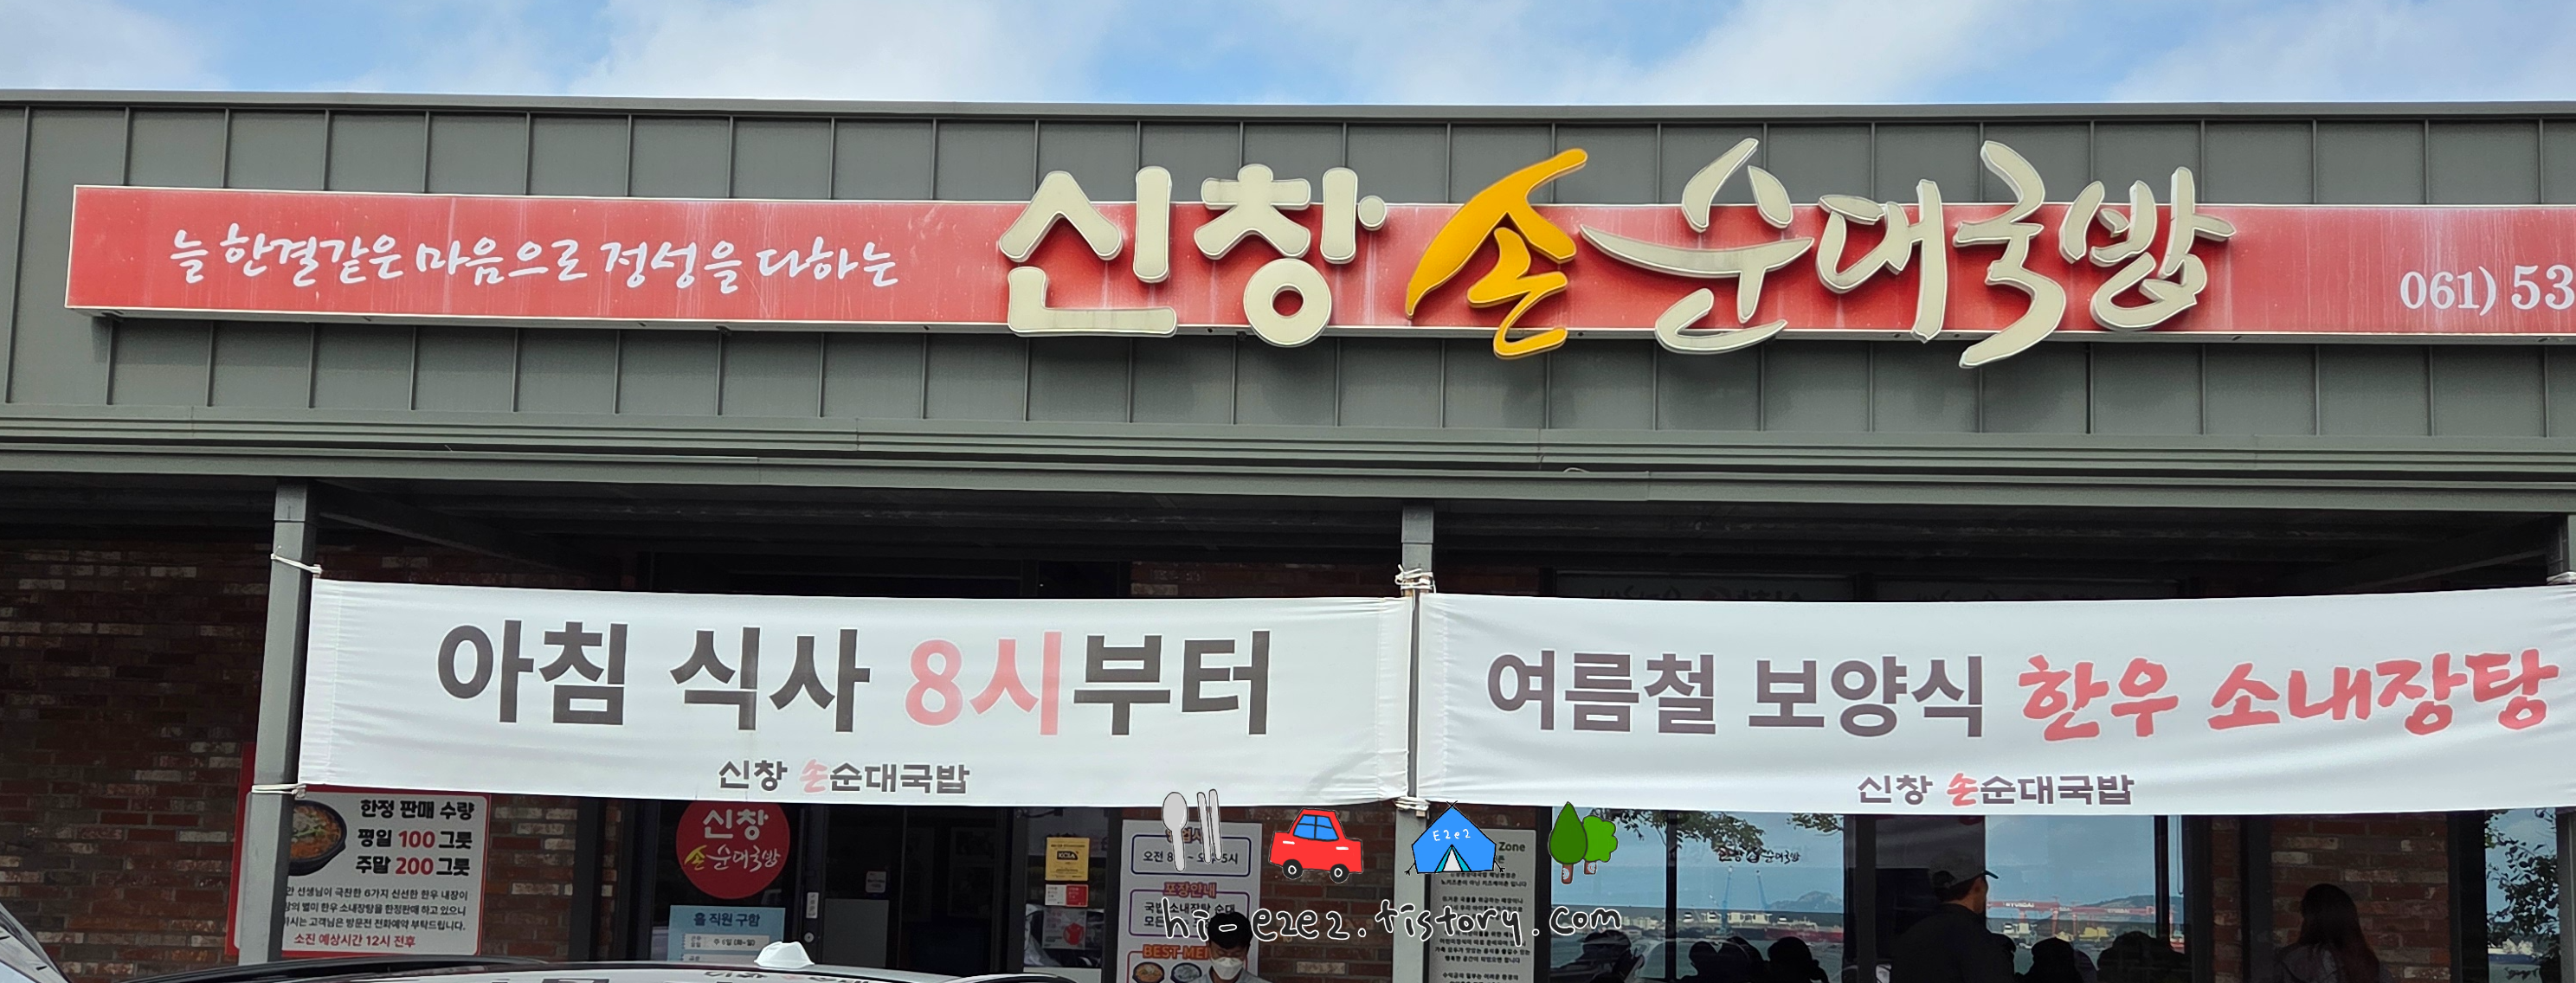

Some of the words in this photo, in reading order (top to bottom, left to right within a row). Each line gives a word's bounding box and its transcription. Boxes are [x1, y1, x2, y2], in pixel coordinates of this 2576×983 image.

[170, 229, 209, 285] 늘
[220, 222, 403, 287] 한결같은
[415, 236, 588, 286] 마음으로
[600, 240, 743, 294] 정성을
[756, 236, 899, 288] 다하는
[998, 164, 1387, 347] 신창
[2399, 265, 2497, 317] 061)
[437, 620, 628, 726] 아침
[669, 626, 871, 733] 식사
[905, 630, 1271, 736] 8시부터
[1487, 650, 1716, 735] 여름철
[1748, 655, 1983, 738] 보양식
[2019, 654, 2180, 742] 한우
[2206, 648, 2560, 736] 소내장탕
[718, 760, 789, 792] 신창
[1857, 774, 1934, 806] 신창
[360, 799, 395, 819] 한정
[400, 800, 435, 819] 판매
[440, 801, 475, 820] 수량
[703, 808, 769, 841] 신창
[357, 828, 392, 848] 평일
[1497, 841, 1526, 852] Zone
[356, 855, 391, 874] 주말
[1143, 851, 1163, 864] 오전
[298, 886, 332, 898] 선생님이
[364, 888, 389, 899] 6가지
[391, 889, 418, 900] 신선한
[421, 890, 438, 900] 한우
[441, 890, 468, 902] 내장이
[1162, 882, 1218, 898] 포장안내
[321, 902, 338, 914] 한우
[422, 904, 438, 916] 하고
[440, 905, 467, 916] 있으니
[309, 917, 345, 928] 고객님은
[374, 918, 409, 930] 전화예약
[709, 912, 732, 927] 직원
[735, 913, 761, 927] 구함
[294, 933, 316, 947] 소진
[319, 933, 363, 948] 예상시간
[366, 935, 390, 948] 12시
[394, 935, 415, 948] 전후
[1143, 944, 1181, 959] BEST
